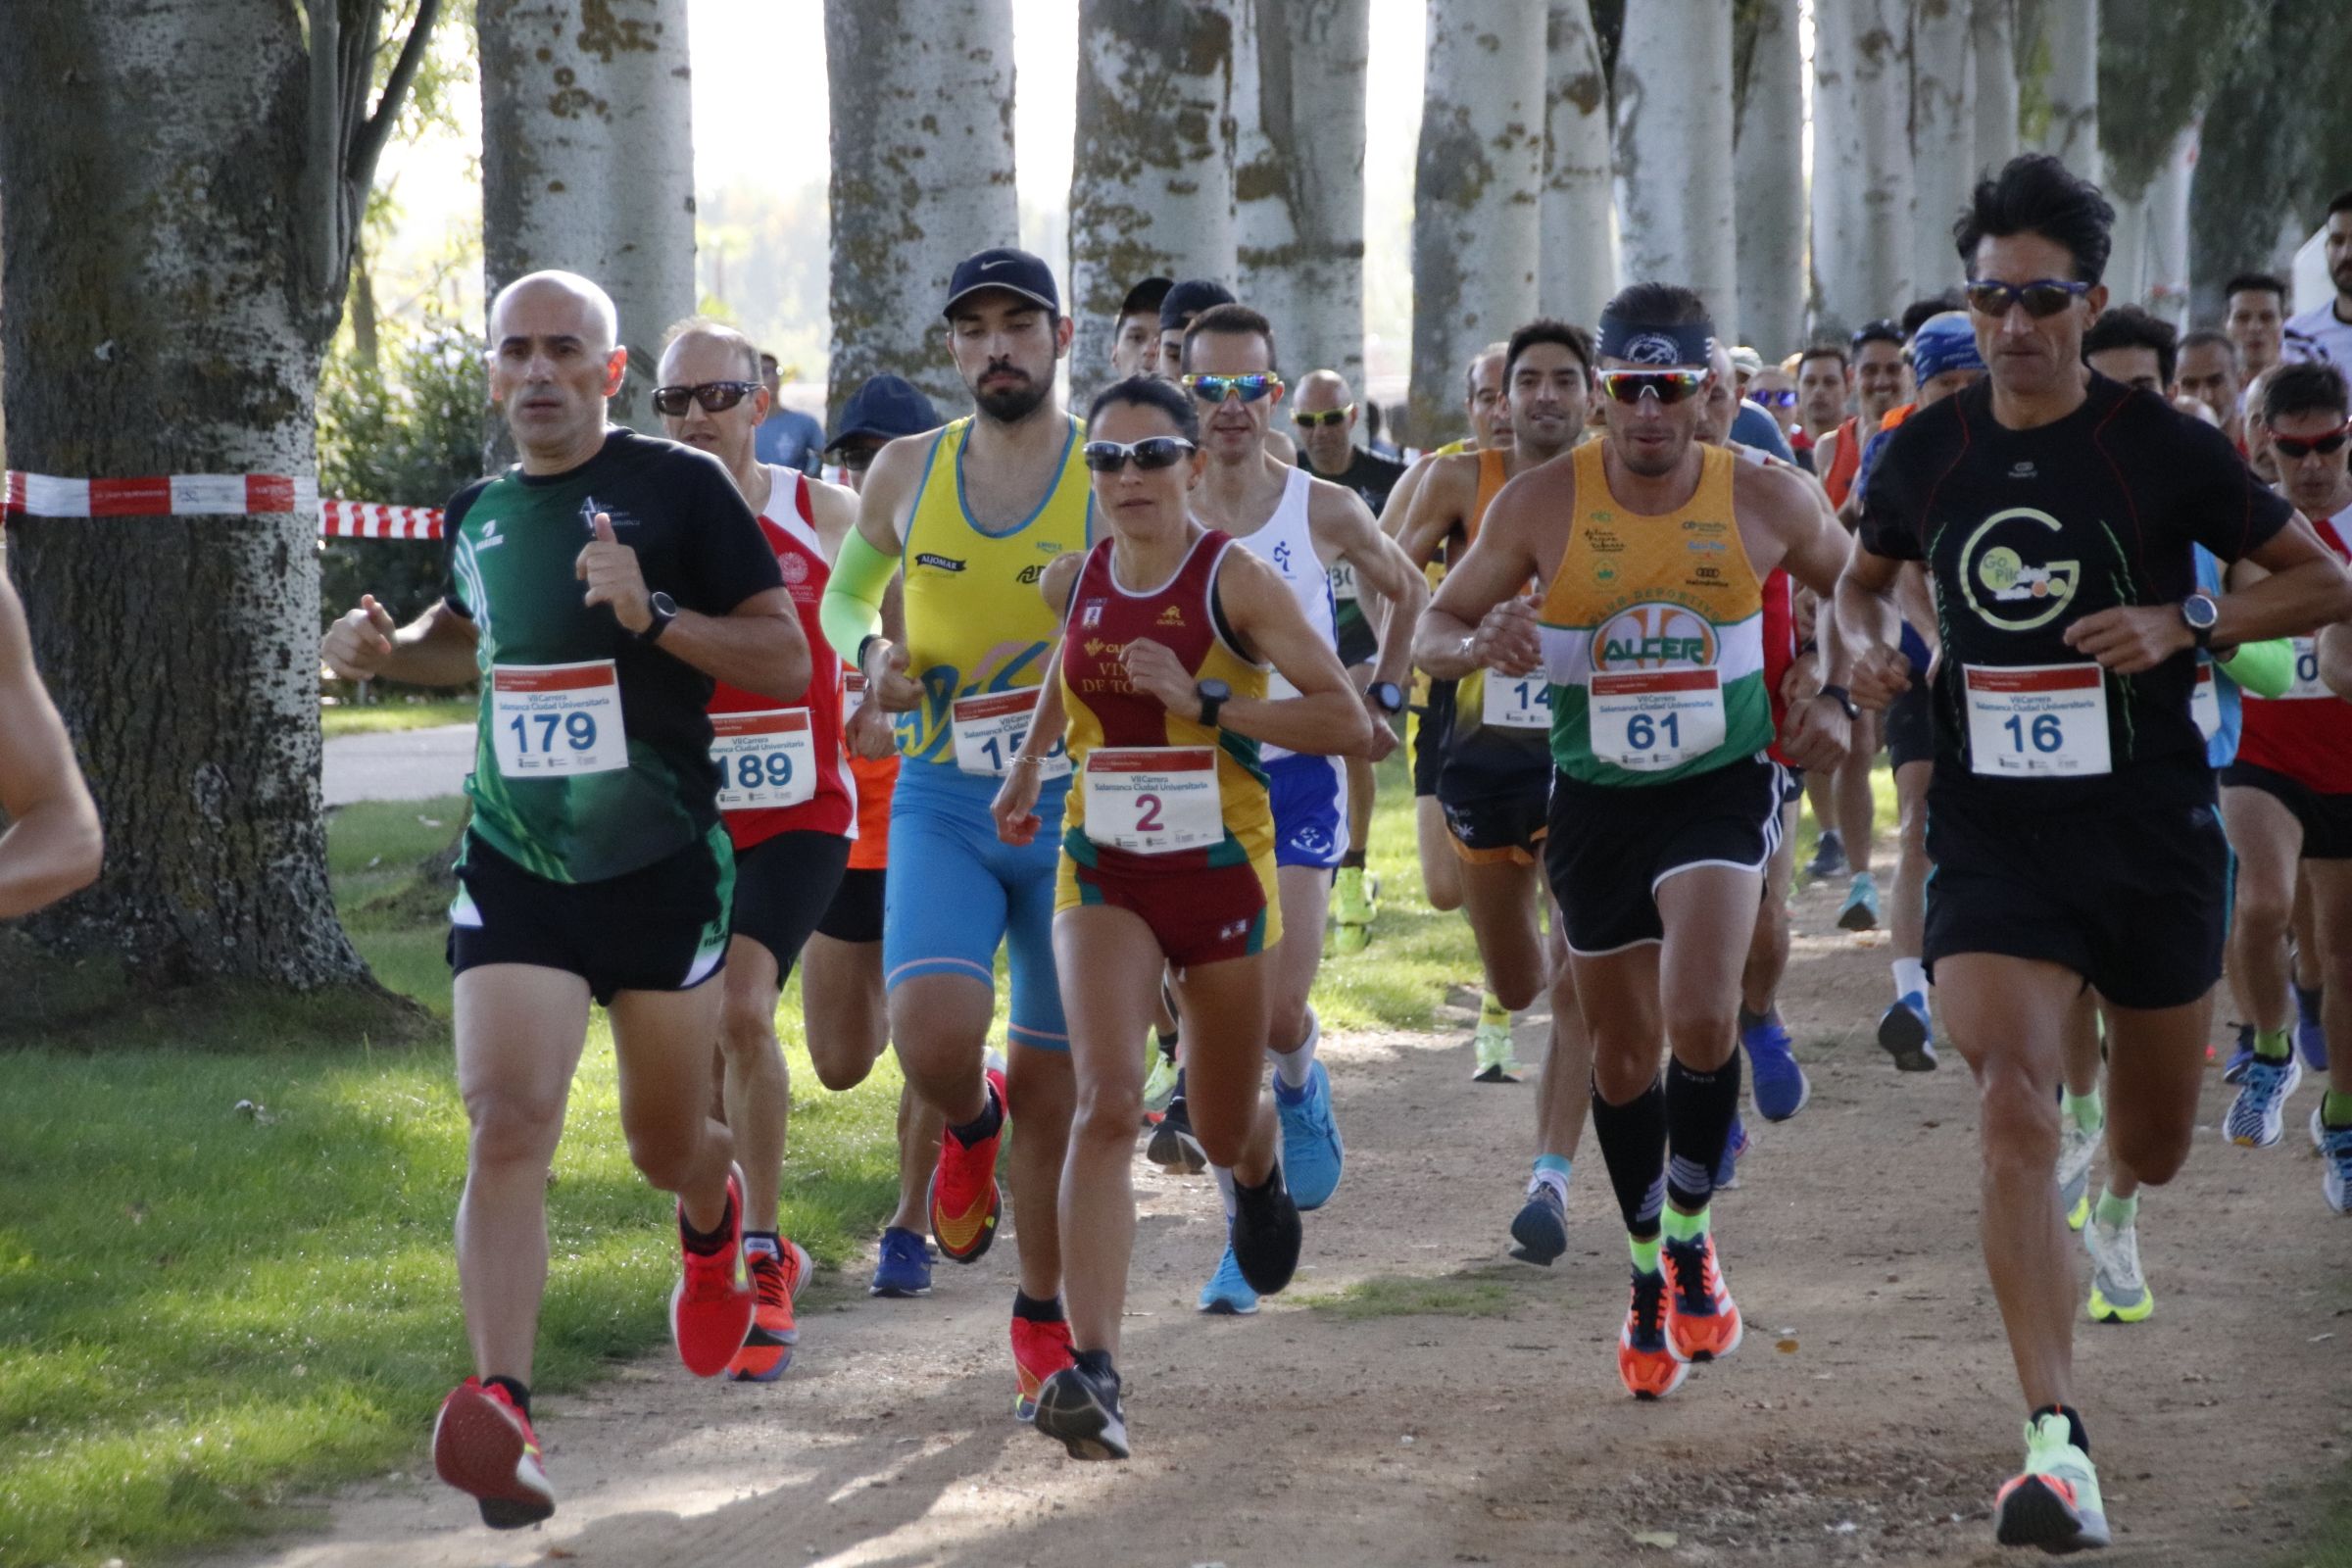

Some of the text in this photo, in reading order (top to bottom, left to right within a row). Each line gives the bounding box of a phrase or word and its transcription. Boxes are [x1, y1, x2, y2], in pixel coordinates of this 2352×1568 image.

[1983, 555, 2008, 568] Go
[1634, 588, 1722, 622] DEPORTIVO
[1602, 637, 1705, 665] ALCER
[1082, 678, 1104, 692] DE
[531, 702, 558, 710] Ciudad
[559, 698, 610, 710] Universitaria
[538, 693, 567, 703] Carrera
[2021, 695, 2052, 704] Carrera
[1667, 701, 1714, 710] Universitaria
[2013, 703, 2040, 711] Ciudad
[2041, 700, 2095, 710] Universitaria
[511, 710, 597, 754] 179
[964, 727, 1002, 739] Salamanca
[1628, 711, 1680, 750] 61
[2004, 713, 2064, 753] 16
[760, 741, 805, 752] Universitaria
[720, 752, 793, 790] 189
[1095, 782, 1208, 792] Salamanca Ciudad Universitaria
[1135, 793, 1164, 832] 2
